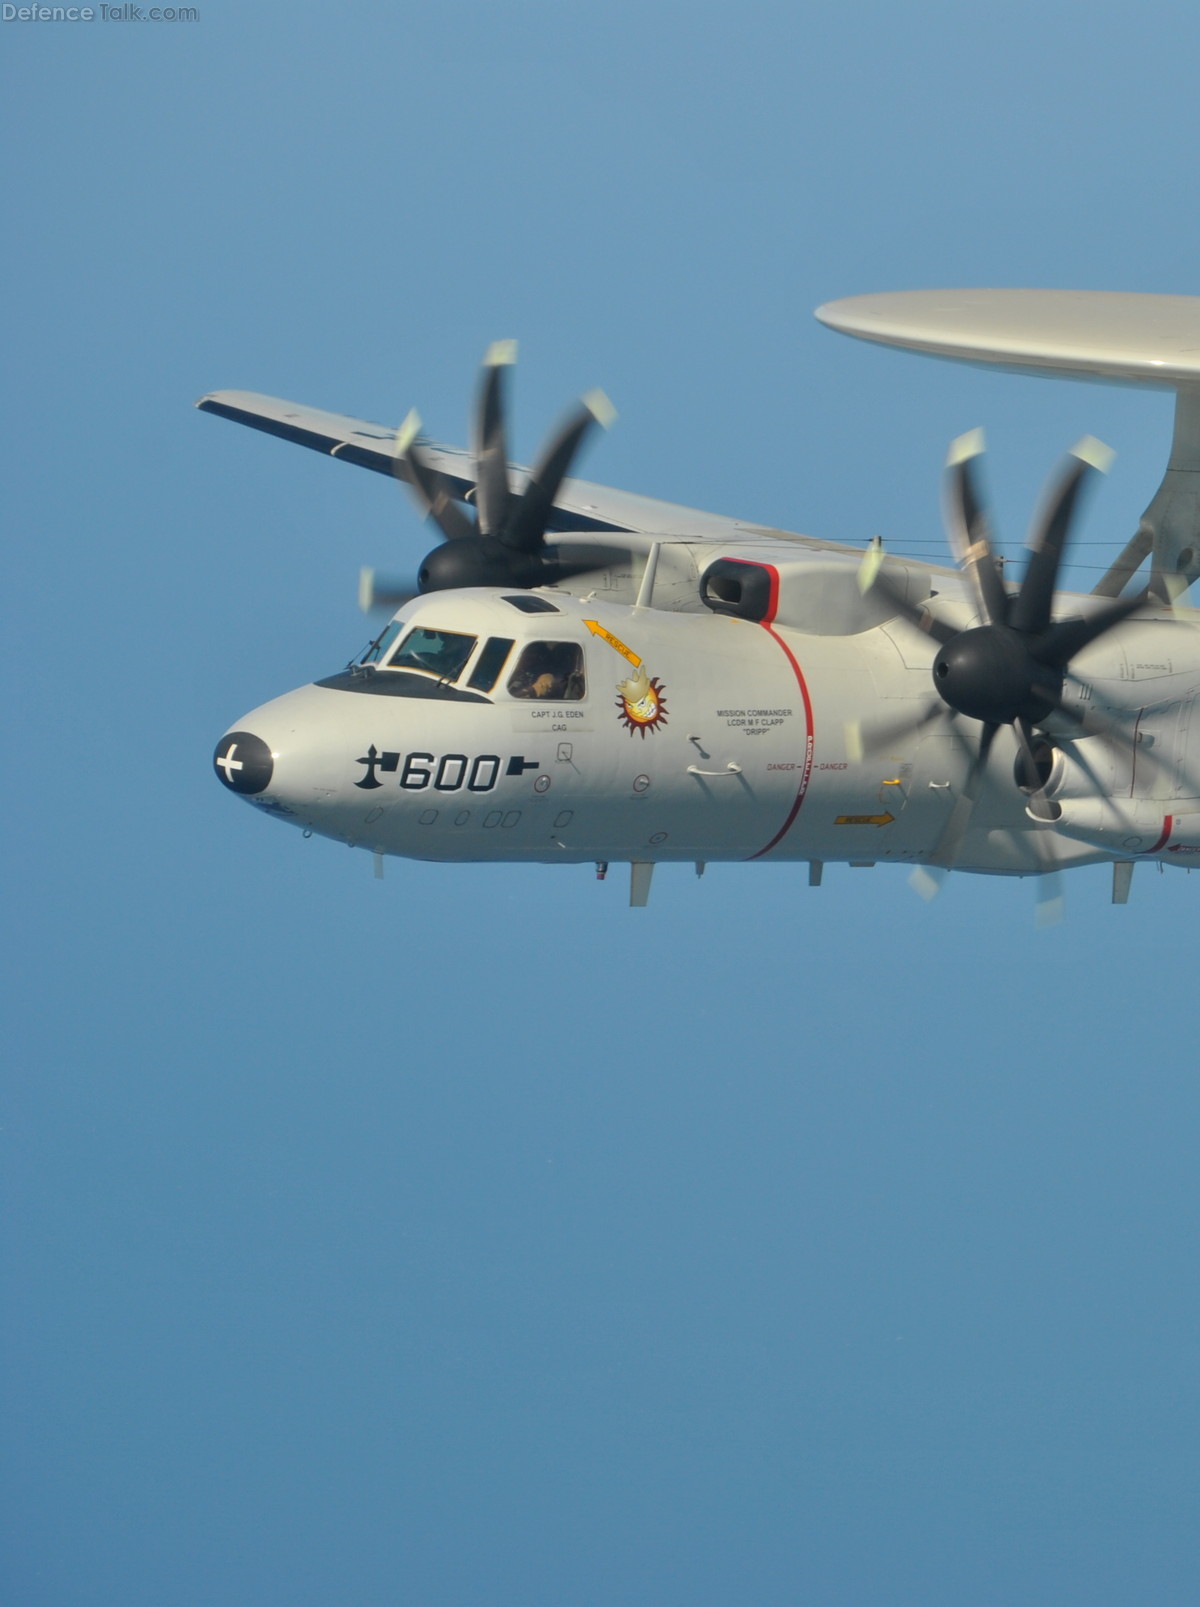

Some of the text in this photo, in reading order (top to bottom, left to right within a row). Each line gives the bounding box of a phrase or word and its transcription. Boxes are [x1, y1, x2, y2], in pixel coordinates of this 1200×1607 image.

[747, 709, 793, 717] COMMANDER
[727, 719, 746, 727] LCDR
[761, 718, 784, 726] CLAPP
[820, 763, 848, 771] DANGER
[400, 752, 503, 794] 600
